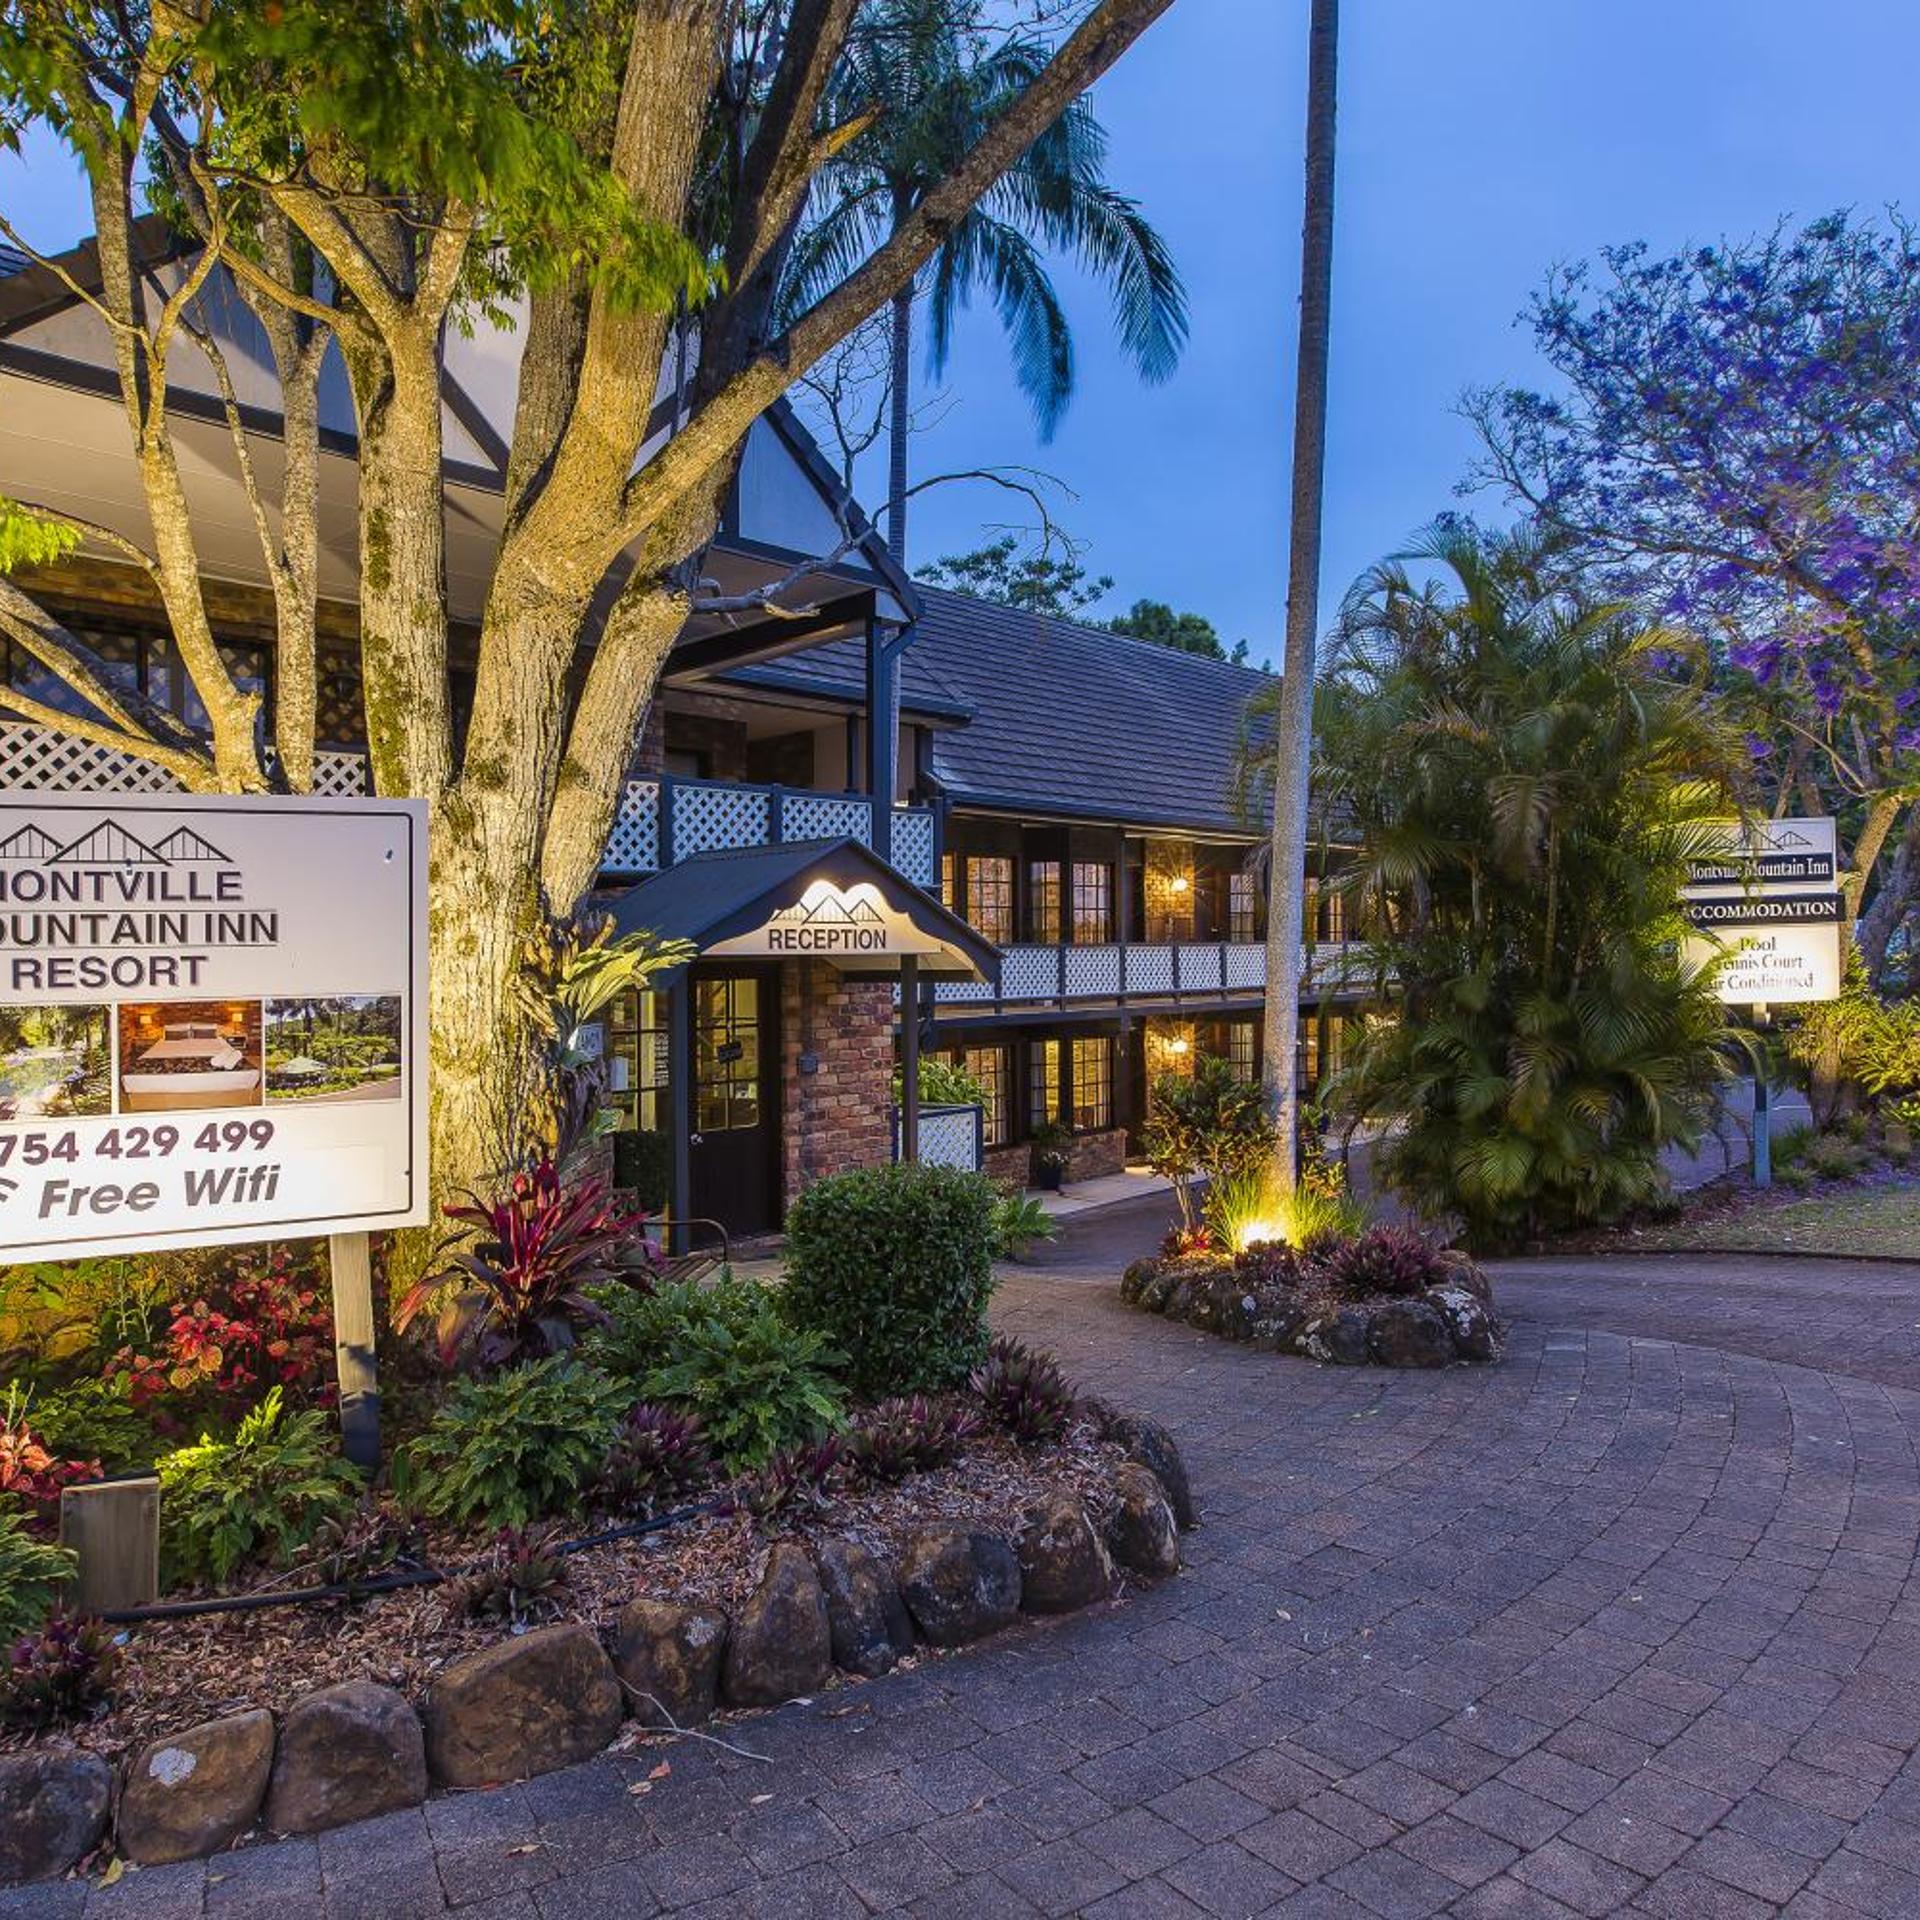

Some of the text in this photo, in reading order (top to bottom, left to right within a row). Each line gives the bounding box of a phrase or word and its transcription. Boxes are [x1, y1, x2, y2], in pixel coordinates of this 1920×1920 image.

[1806, 857, 1830, 875] Inn
[1686, 901, 1837, 920] CCOMMODATION
[205, 912, 278, 943] INN
[768, 928, 887, 950] RECEPTION
[1740, 936, 1776, 951] Pool
[12, 955, 208, 990] RESORT
[1721, 953, 1803, 971] ennis Court
[95, 1125, 180, 1160] 429
[194, 1119, 275, 1153] 499
[38, 1164, 281, 1220] Free Wifi
